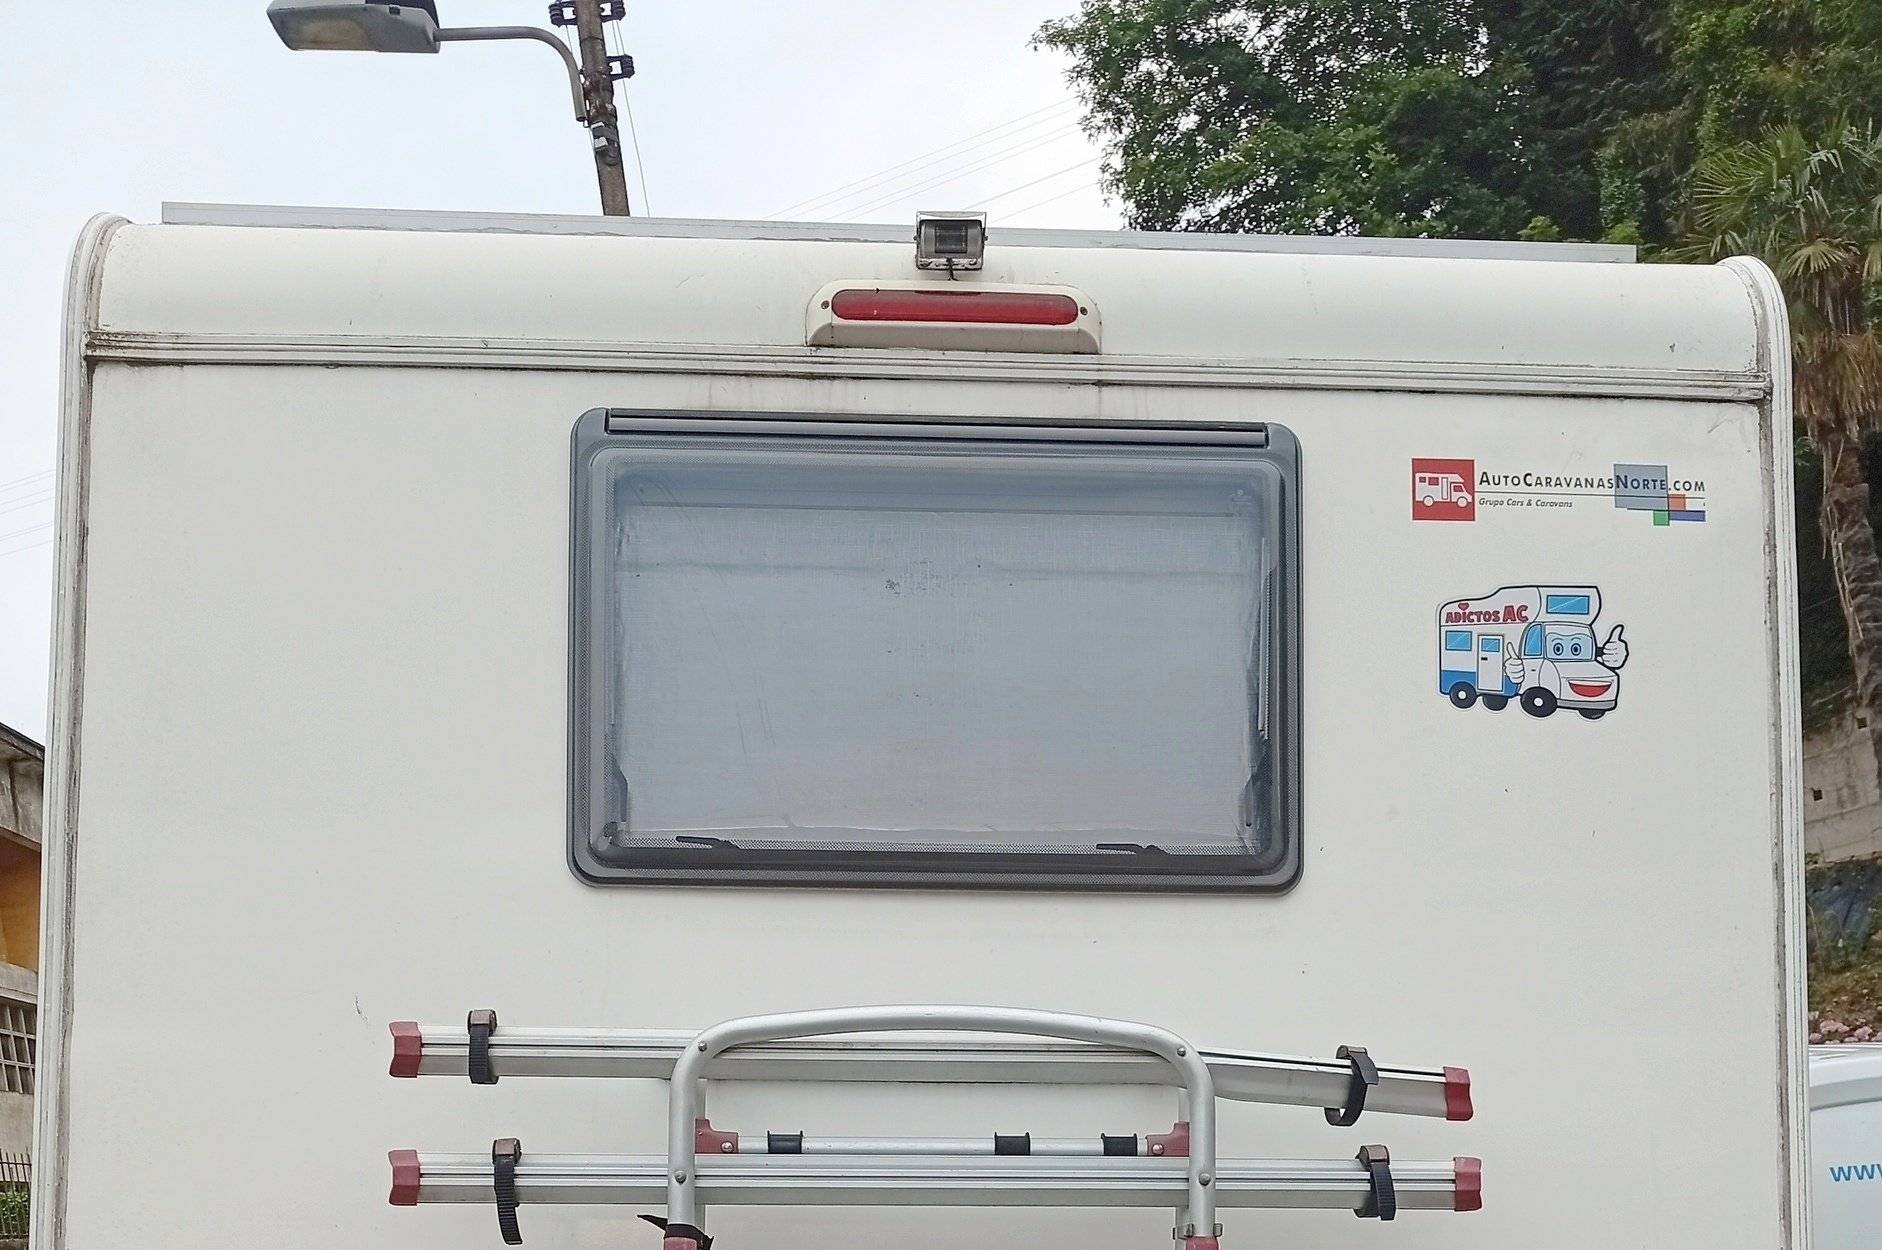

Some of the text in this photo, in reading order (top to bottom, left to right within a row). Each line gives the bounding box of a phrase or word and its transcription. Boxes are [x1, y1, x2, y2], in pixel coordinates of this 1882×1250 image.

[1479, 498, 1573, 508] Grupo Cars & Caravans
[1445, 604, 1529, 623] ADICTOS AC
